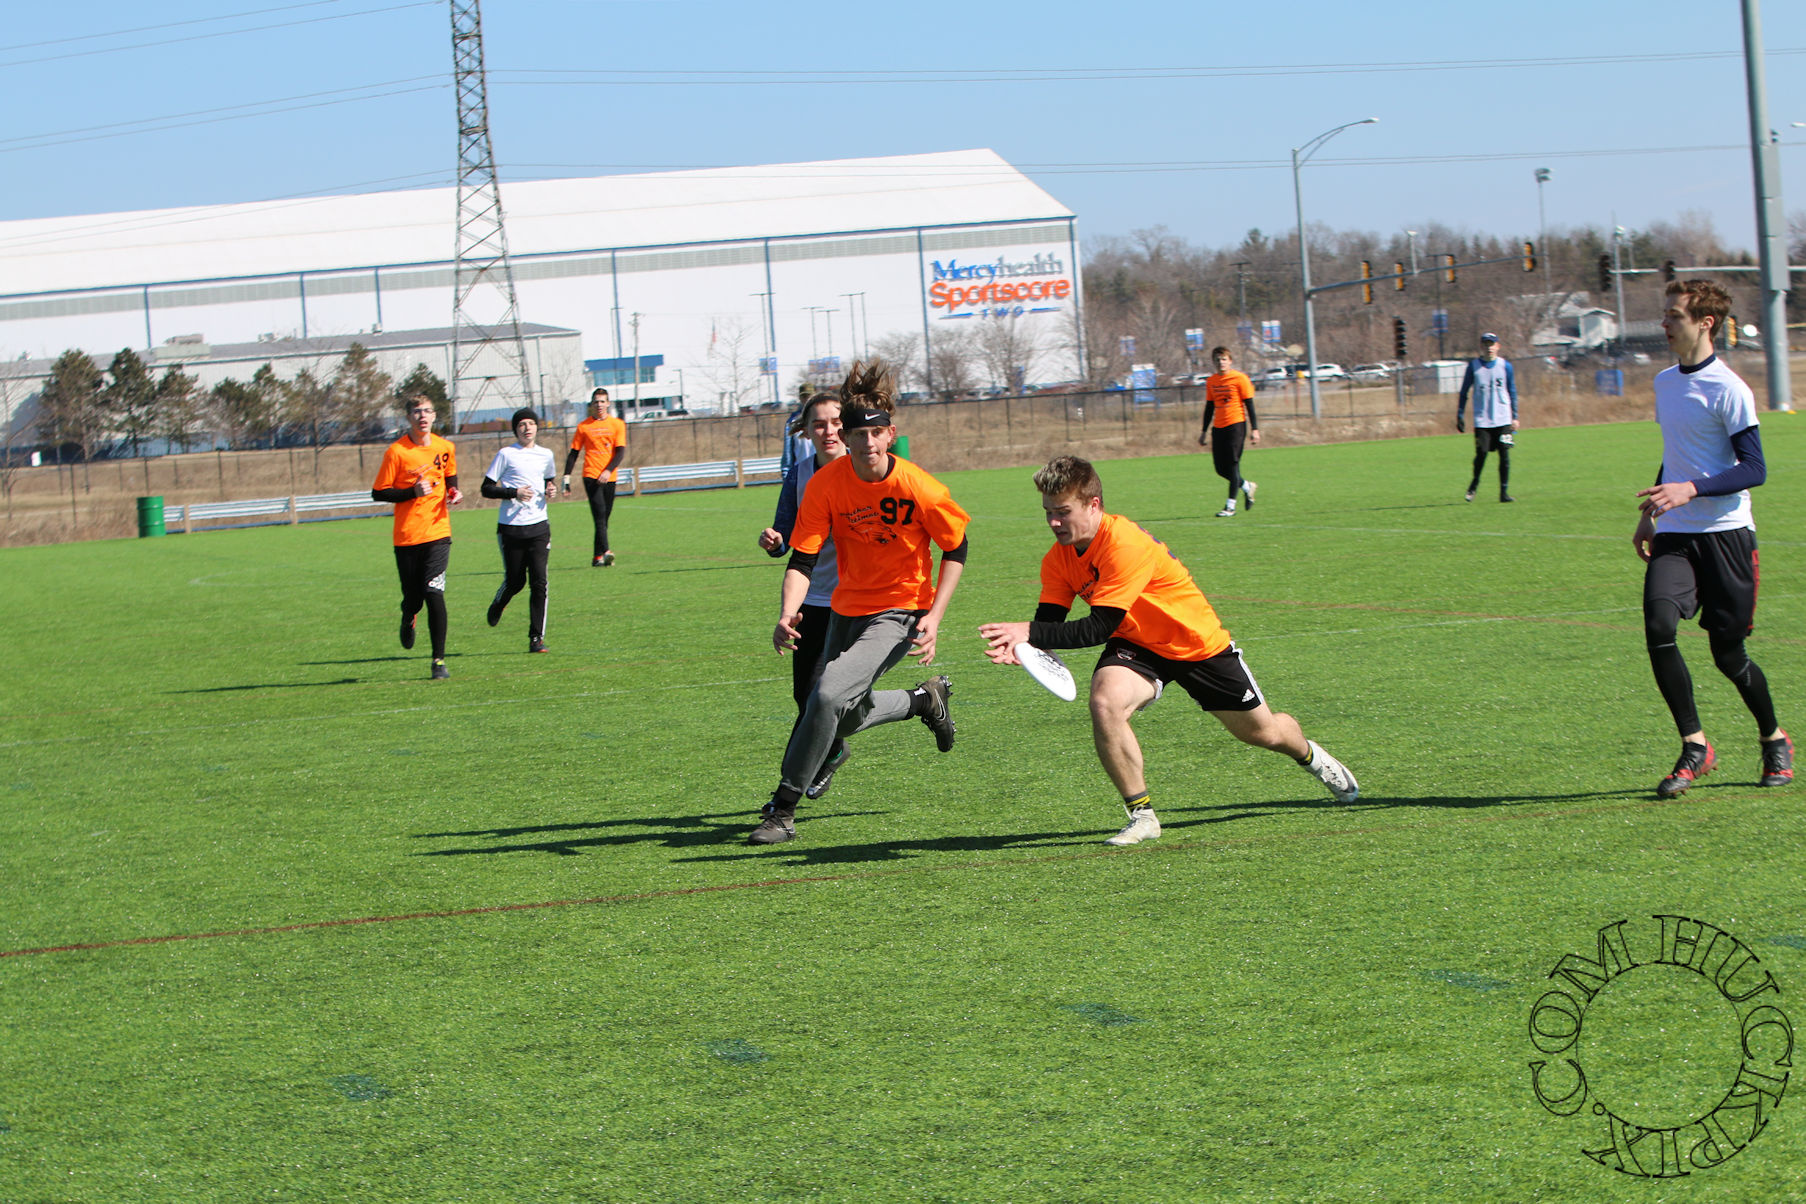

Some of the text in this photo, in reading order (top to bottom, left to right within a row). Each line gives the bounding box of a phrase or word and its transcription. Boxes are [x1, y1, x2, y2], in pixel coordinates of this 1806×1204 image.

[930, 252, 1062, 283] Mercyhealth
[930, 279, 1070, 311] Sportscore
[980, 305, 1025, 318] TWO
[433, 453, 449, 470] 49
[880, 497, 915, 525] 97
